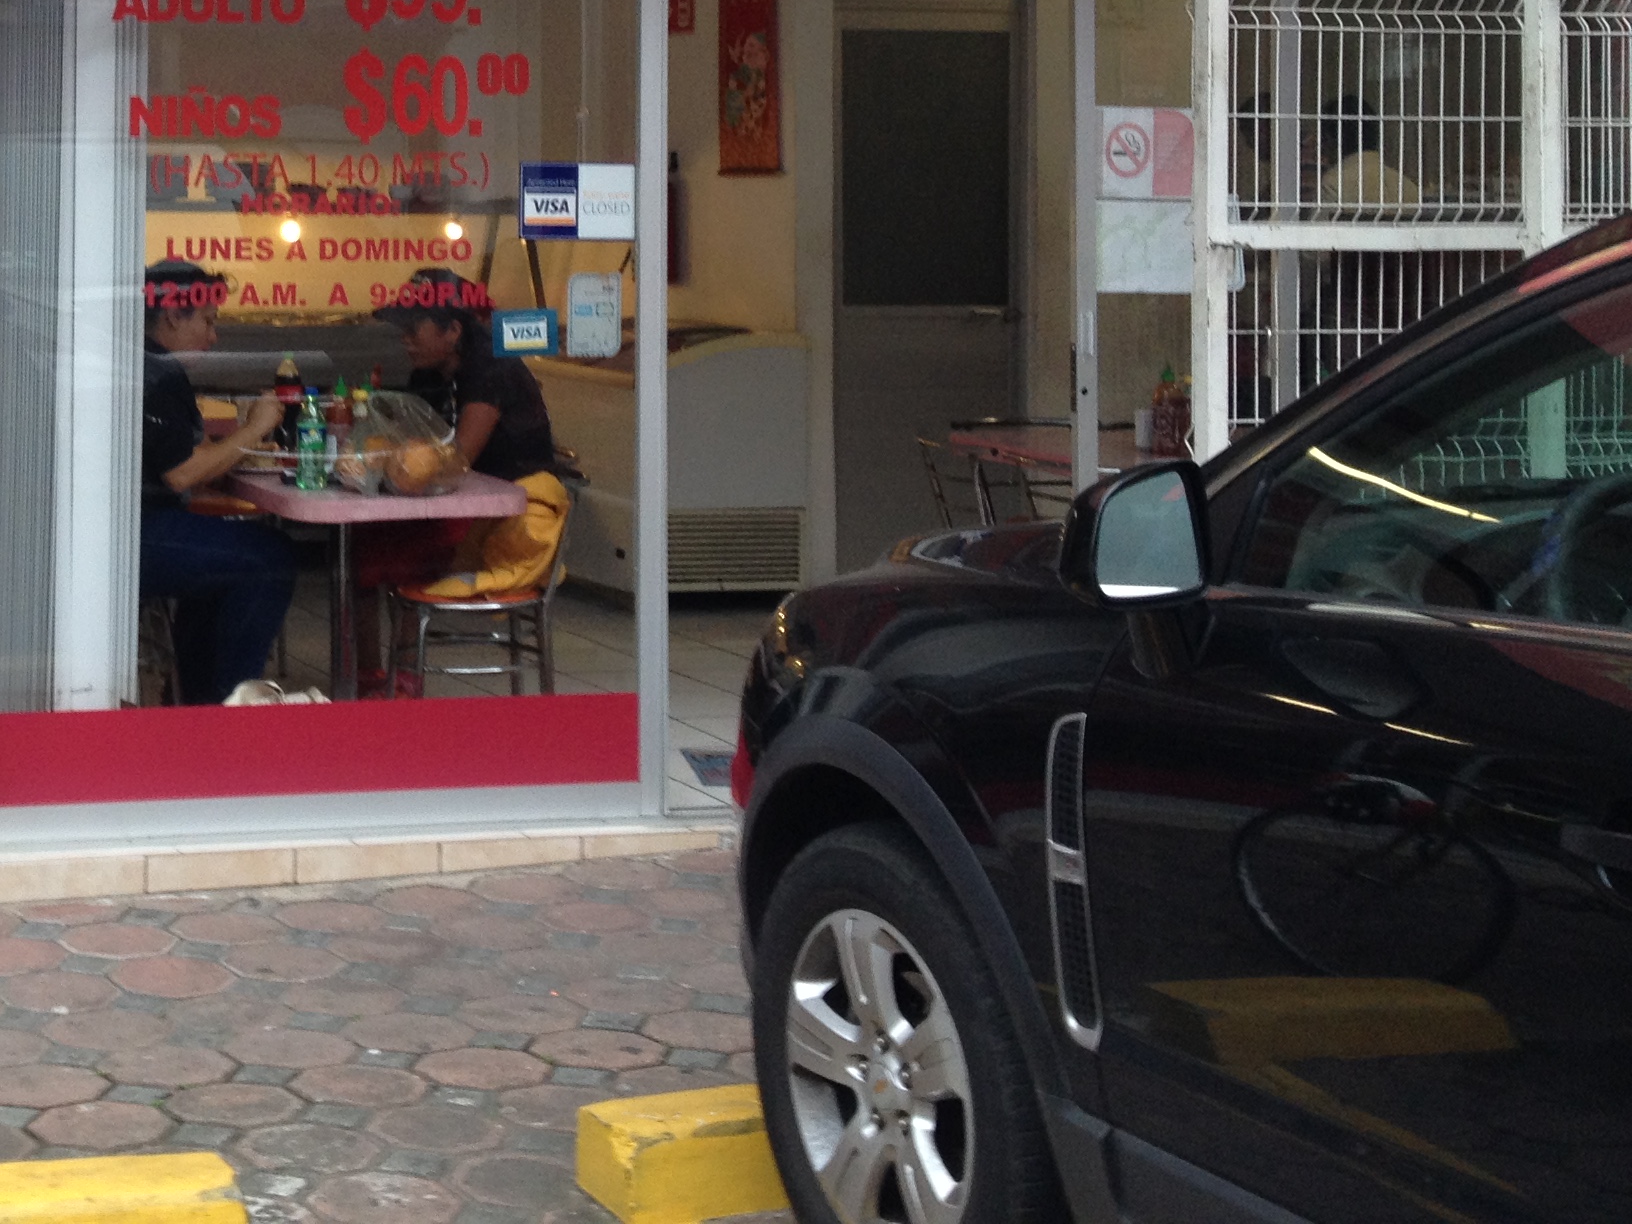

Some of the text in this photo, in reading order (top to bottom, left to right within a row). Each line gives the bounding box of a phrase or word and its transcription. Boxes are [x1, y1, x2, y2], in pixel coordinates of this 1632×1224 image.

[129, 45, 531, 146] NIÑOS $60.00
[149, 151, 491, 195] (HASTA 1.40 MTS.)
[238, 191, 403, 218] HORARIO:
[533, 197, 570, 214] VISA
[582, 199, 631, 216] CLOSED
[164, 236, 474, 263] LUNES A DOMINGO
[142, 281, 228, 309] 12:00
[239, 282, 307, 309] A.M.
[328, 283, 349, 308] A
[510, 326, 542, 339] VISA
